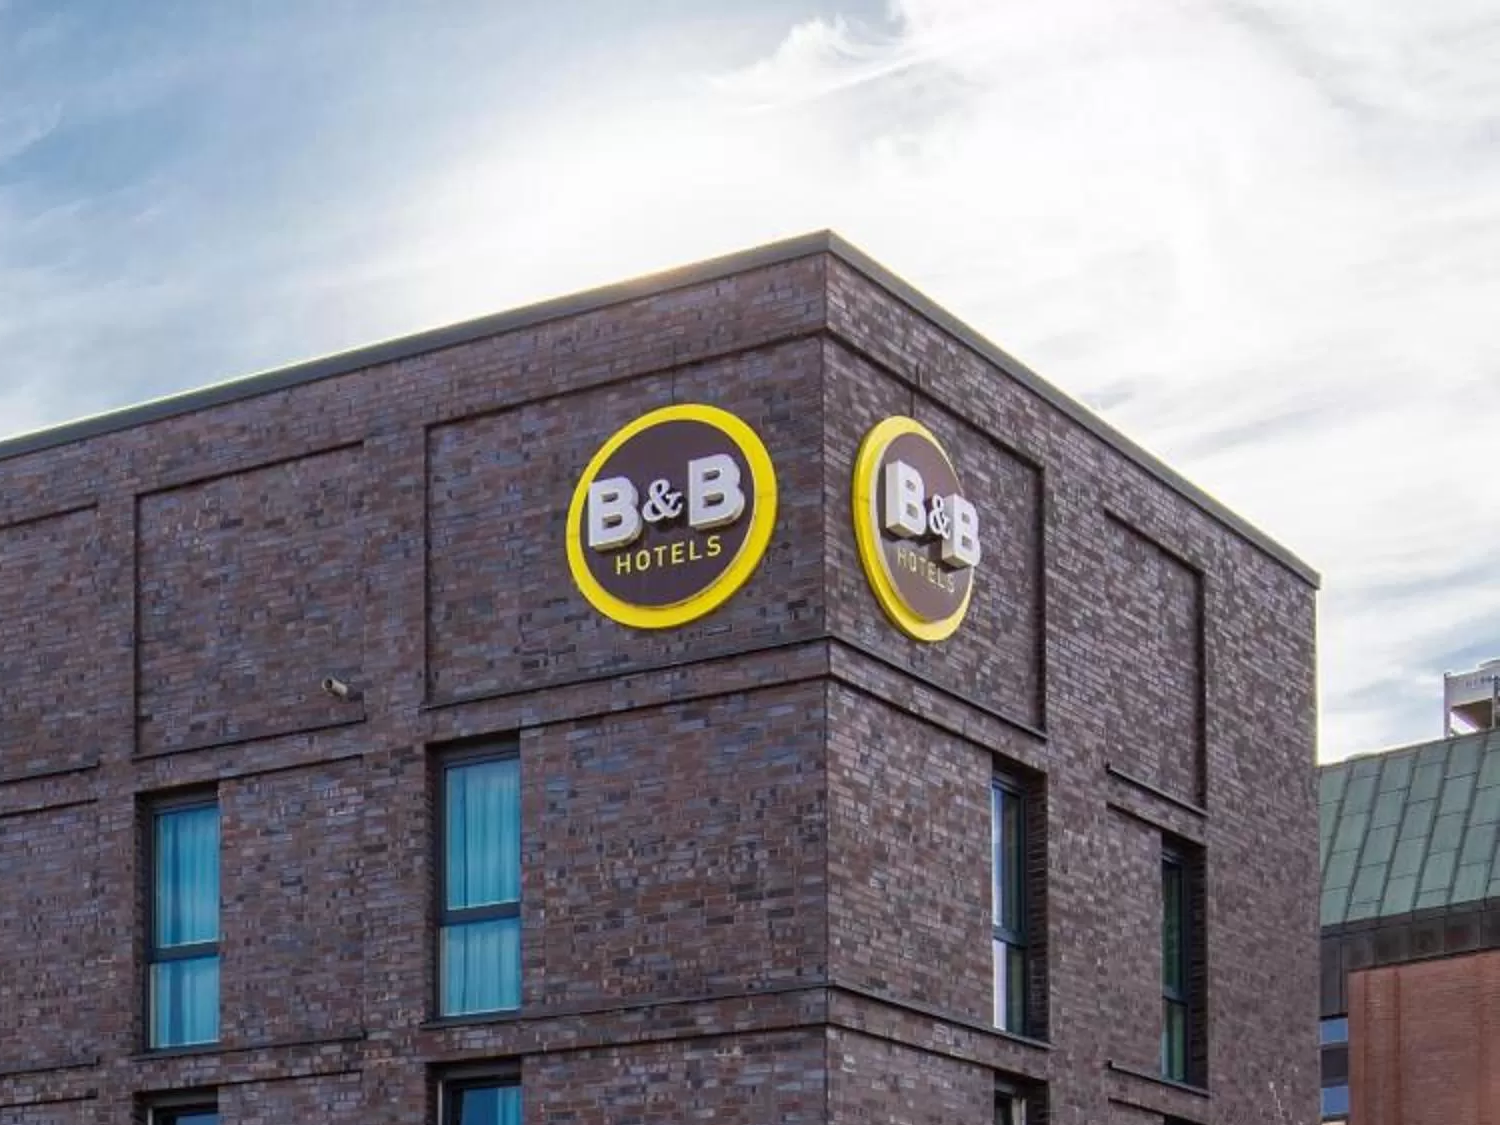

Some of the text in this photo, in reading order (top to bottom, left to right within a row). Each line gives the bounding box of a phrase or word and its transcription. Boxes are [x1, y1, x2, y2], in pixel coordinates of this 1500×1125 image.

[588, 453, 745, 552] B&B
[885, 460, 981, 568] B&B
[615, 535, 722, 575] HOTELS
[897, 548, 956, 593] HOTELS
